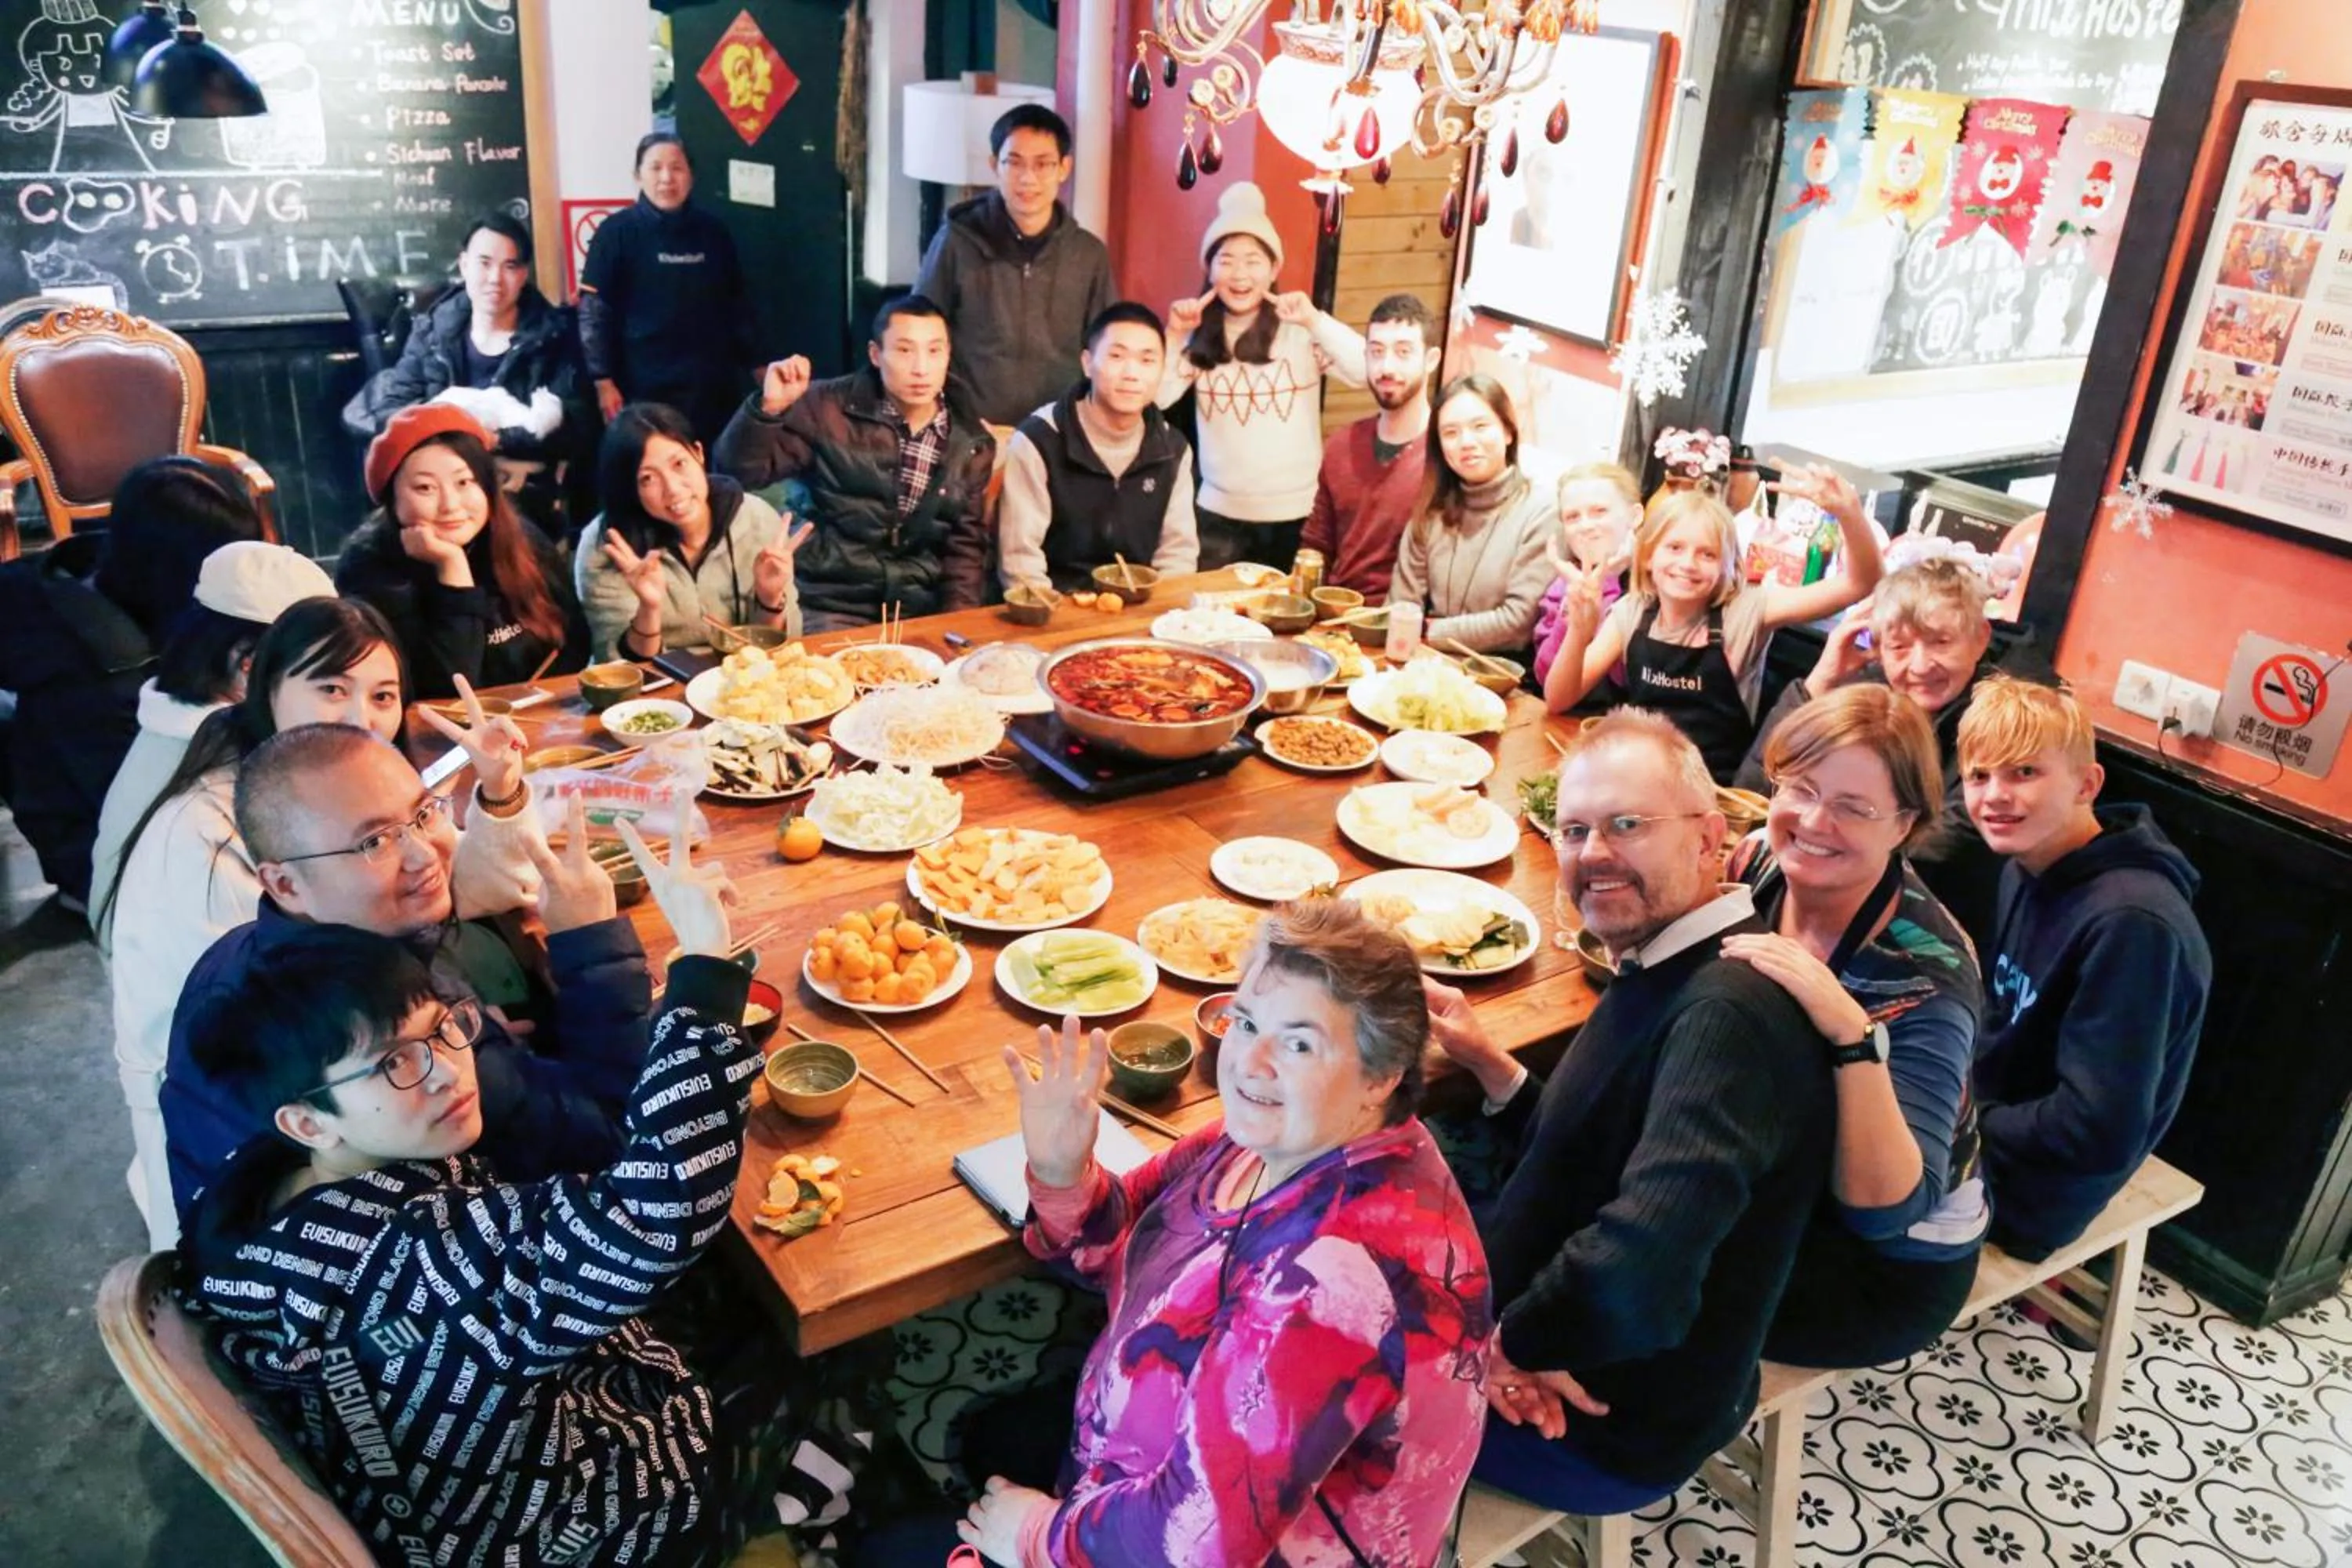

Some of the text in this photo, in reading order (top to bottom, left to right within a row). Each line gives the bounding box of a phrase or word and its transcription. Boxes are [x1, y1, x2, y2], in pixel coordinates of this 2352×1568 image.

[350, 0, 460, 26] MENU
[441, 42, 476, 62] Set
[394, 196, 452, 212] More
[2234, 729, 2252, 745] No
